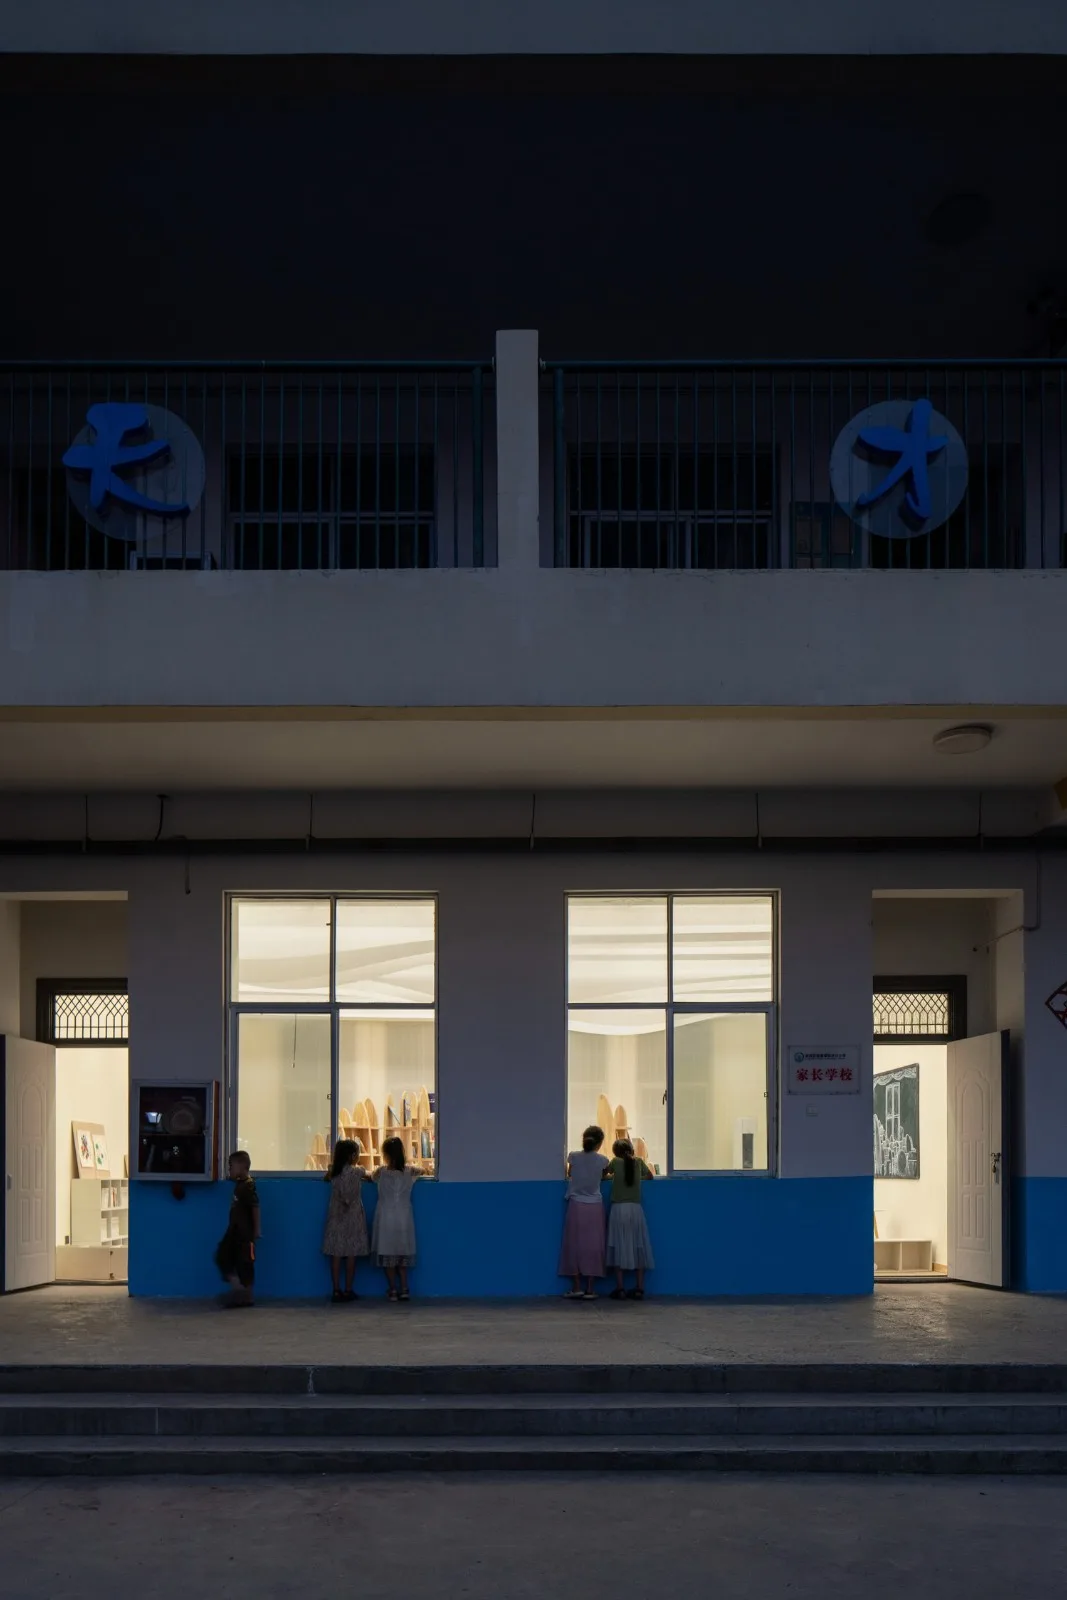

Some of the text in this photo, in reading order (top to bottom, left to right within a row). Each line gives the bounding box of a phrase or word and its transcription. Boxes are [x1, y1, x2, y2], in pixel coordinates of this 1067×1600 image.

[857, 398, 947, 520] 才
[797, 1067, 853, 1082] 家长学校
